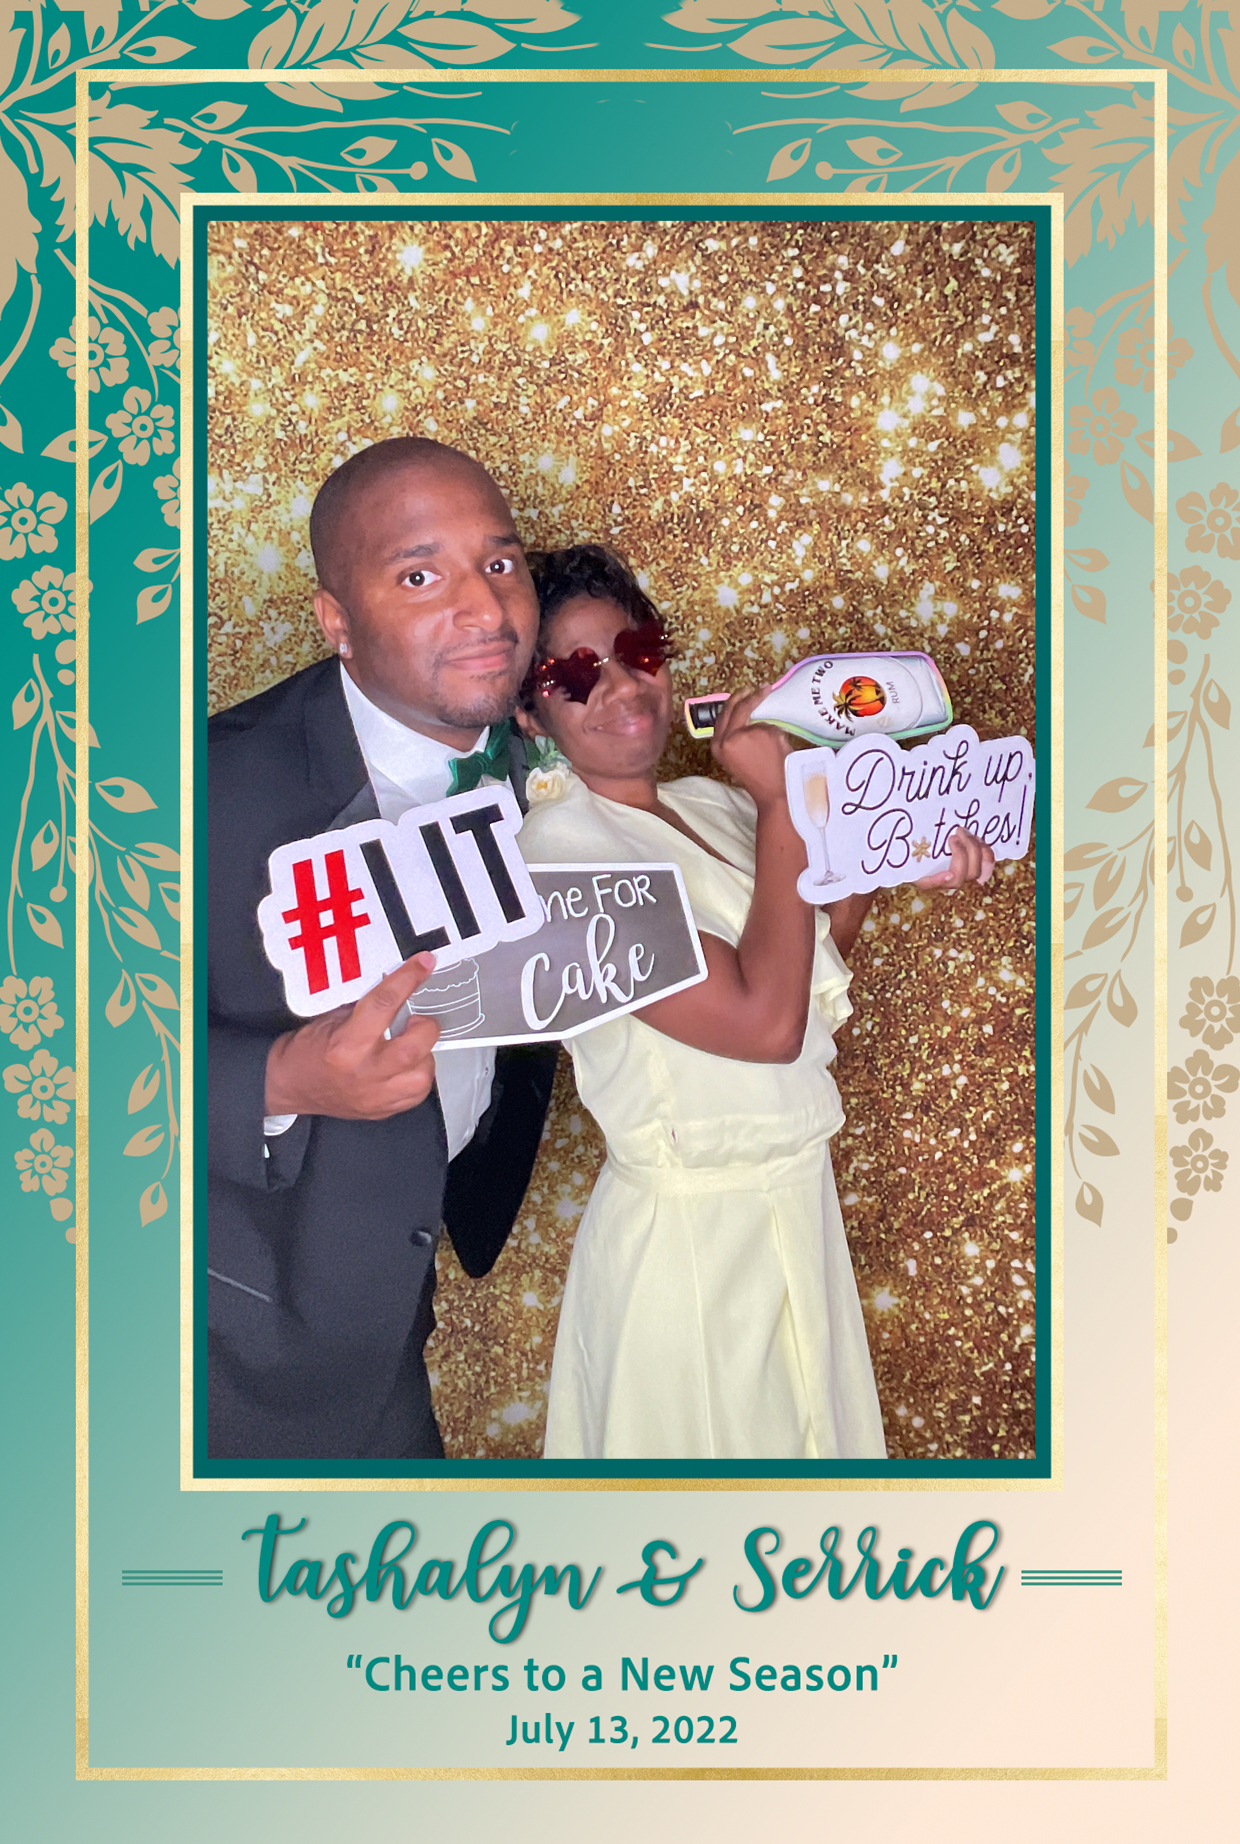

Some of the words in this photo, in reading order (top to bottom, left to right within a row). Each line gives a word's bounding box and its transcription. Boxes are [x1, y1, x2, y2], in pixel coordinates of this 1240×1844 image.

[812, 660, 834, 684] TWO
[811, 687, 823, 705] ME
[886, 681, 900, 704] RUM
[818, 707, 856, 736] MAKE
[841, 740, 972, 815] Drink
[281, 803, 527, 995] #LIT
[521, 913, 655, 1030] Cake
